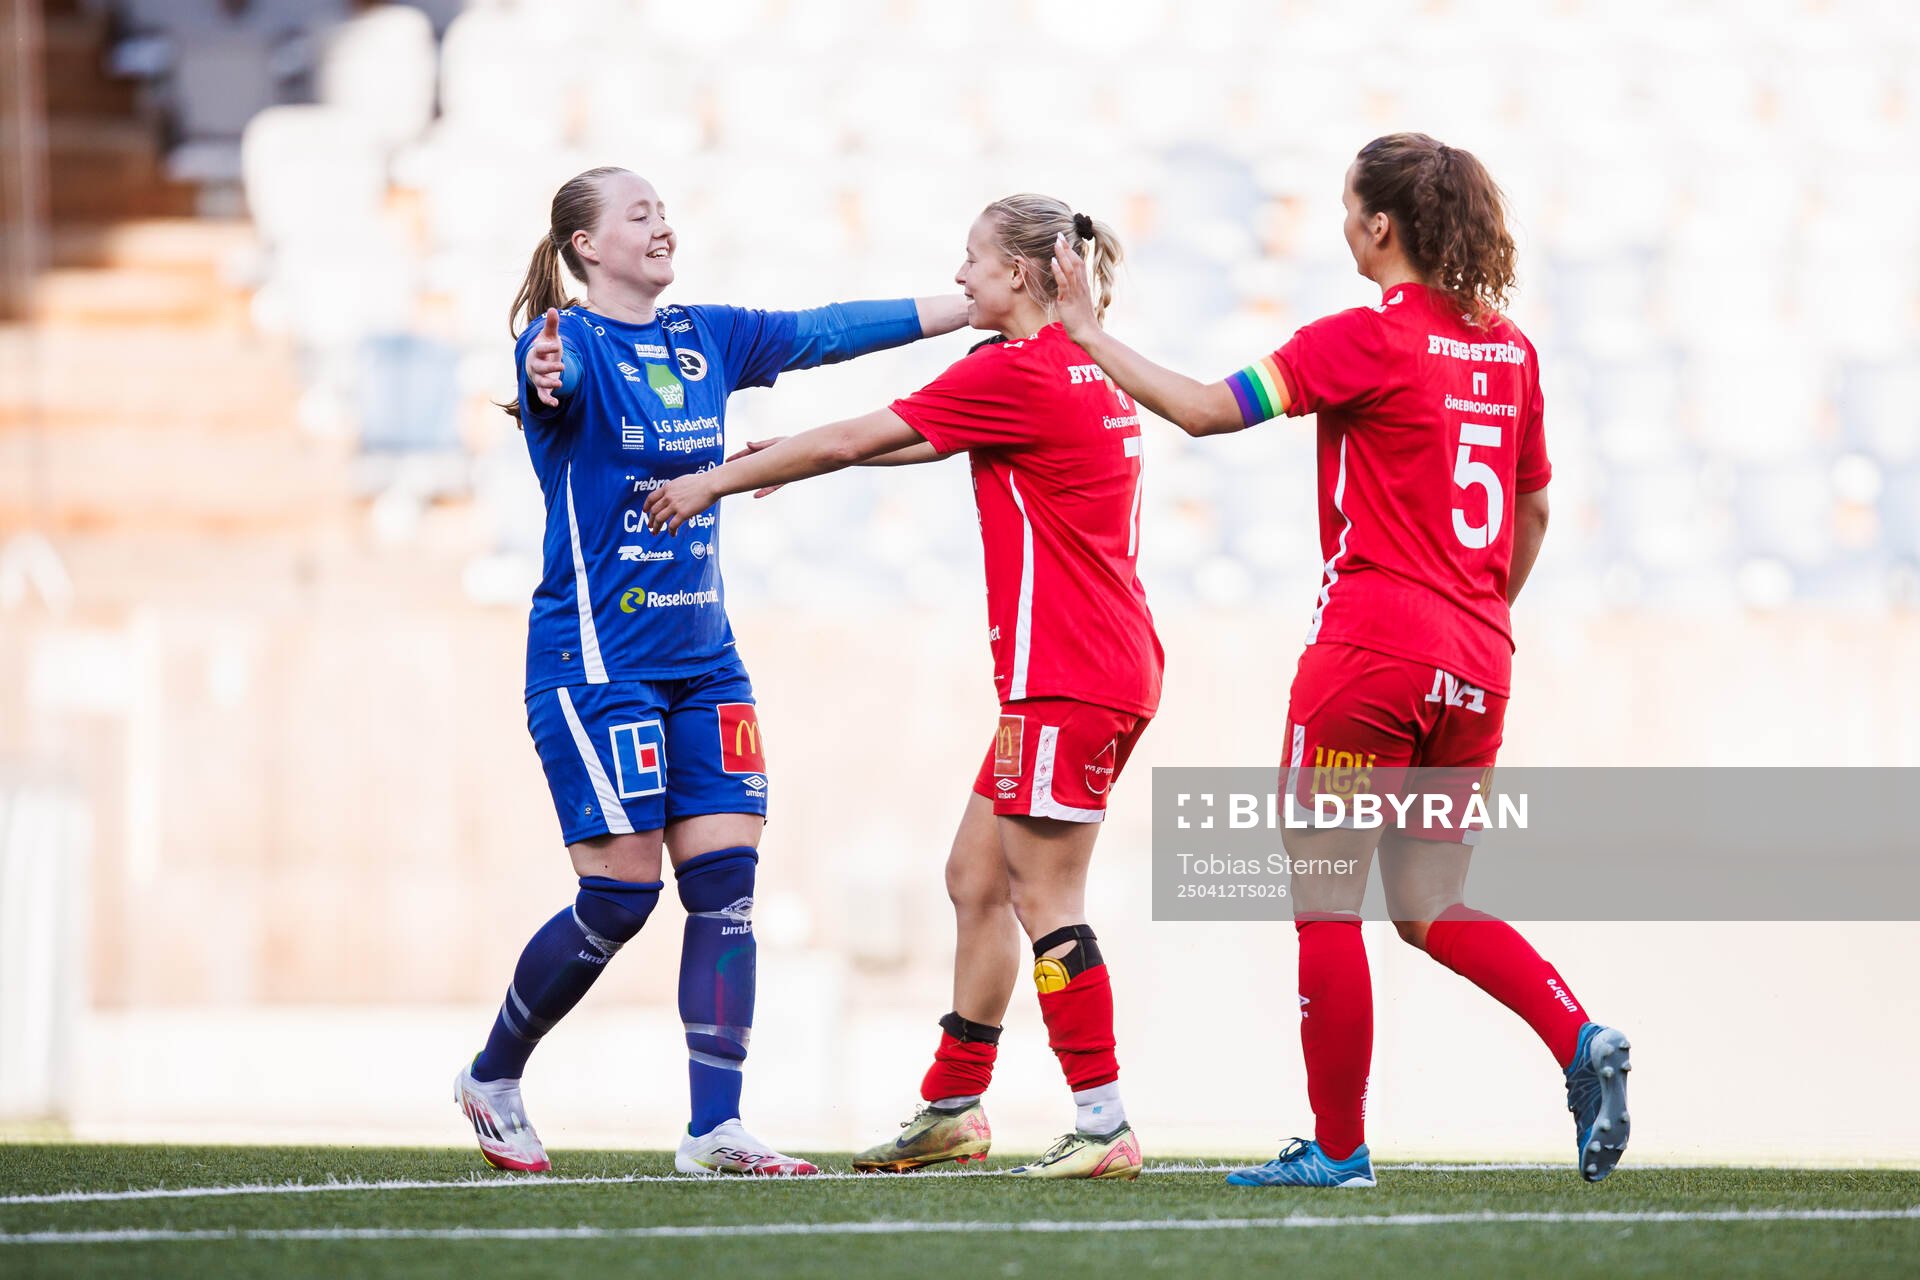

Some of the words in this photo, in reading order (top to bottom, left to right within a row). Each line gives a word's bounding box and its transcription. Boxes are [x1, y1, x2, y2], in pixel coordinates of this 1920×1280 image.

[652, 420, 673, 433] LG
[658, 435, 715, 454] Fastigheter
[1122, 435, 1143, 556] 7
[1452, 422, 1504, 549] 5
[1546, 978, 1578, 1013] umbro
